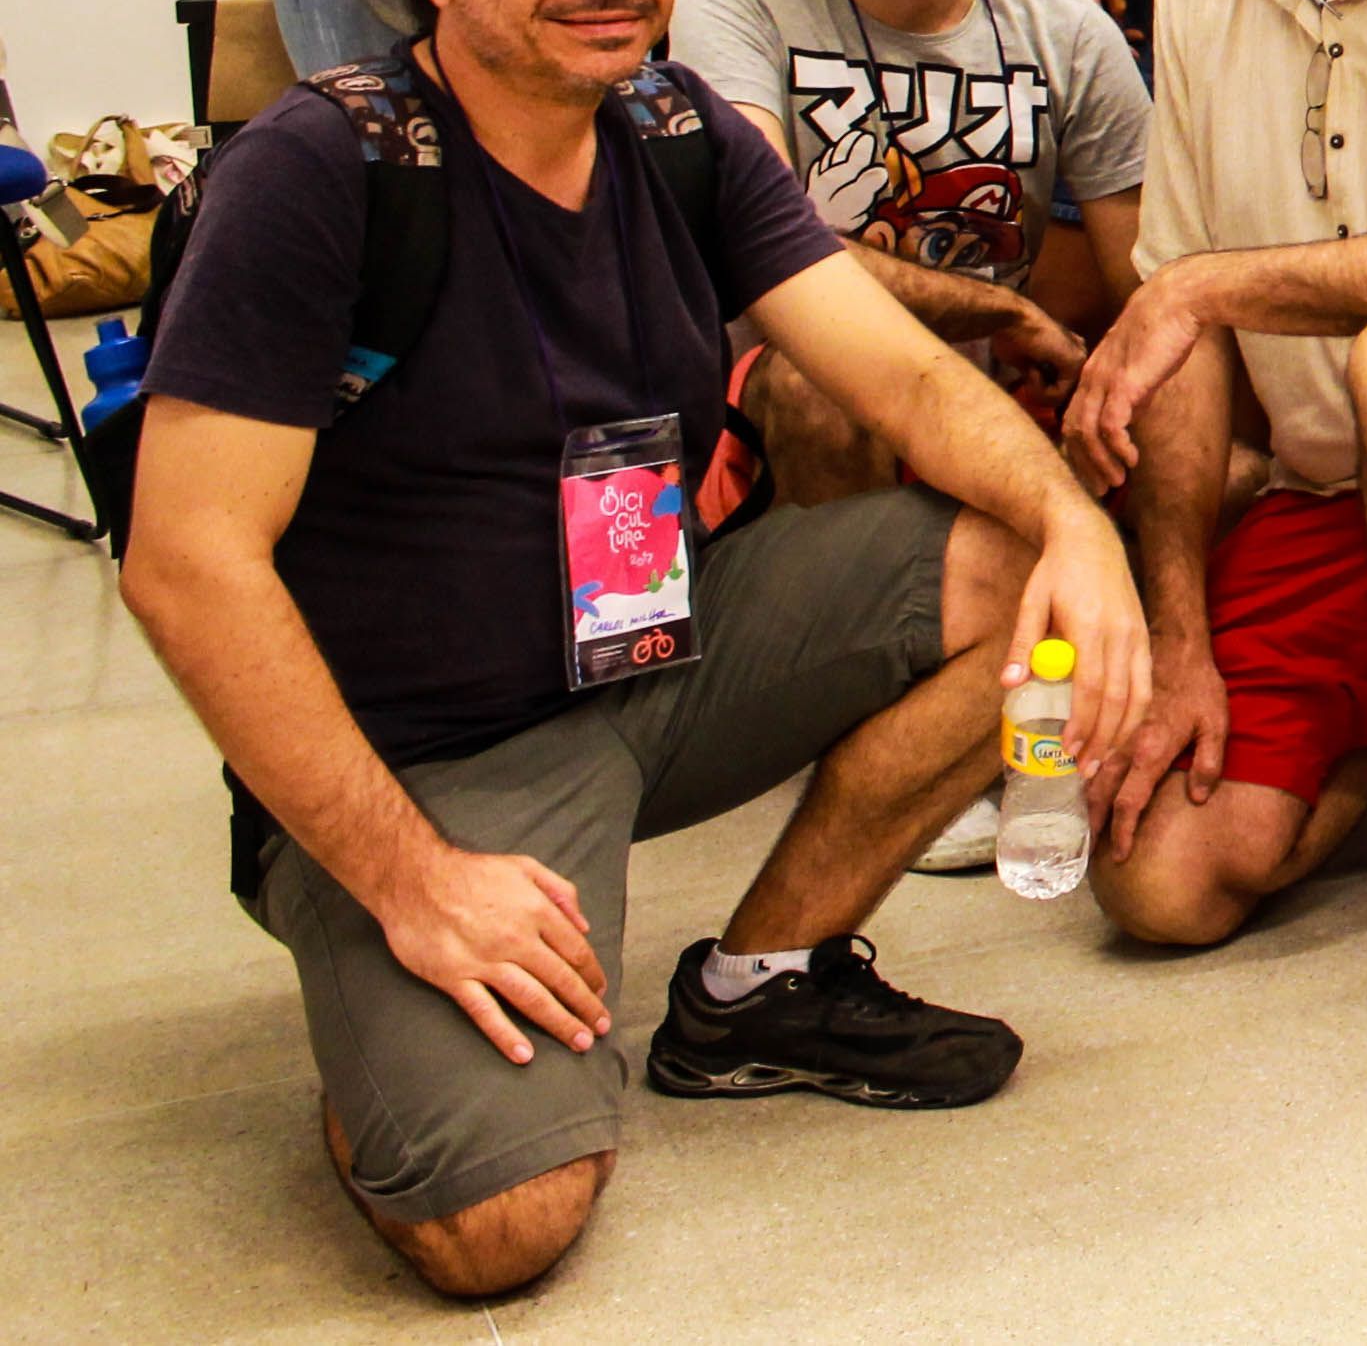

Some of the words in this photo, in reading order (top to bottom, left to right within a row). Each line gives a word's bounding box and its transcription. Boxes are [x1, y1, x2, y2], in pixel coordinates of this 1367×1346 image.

[788, 46, 1048, 168] マリオ
[600, 485, 643, 516] BICI
[615, 512, 650, 530] CUL
